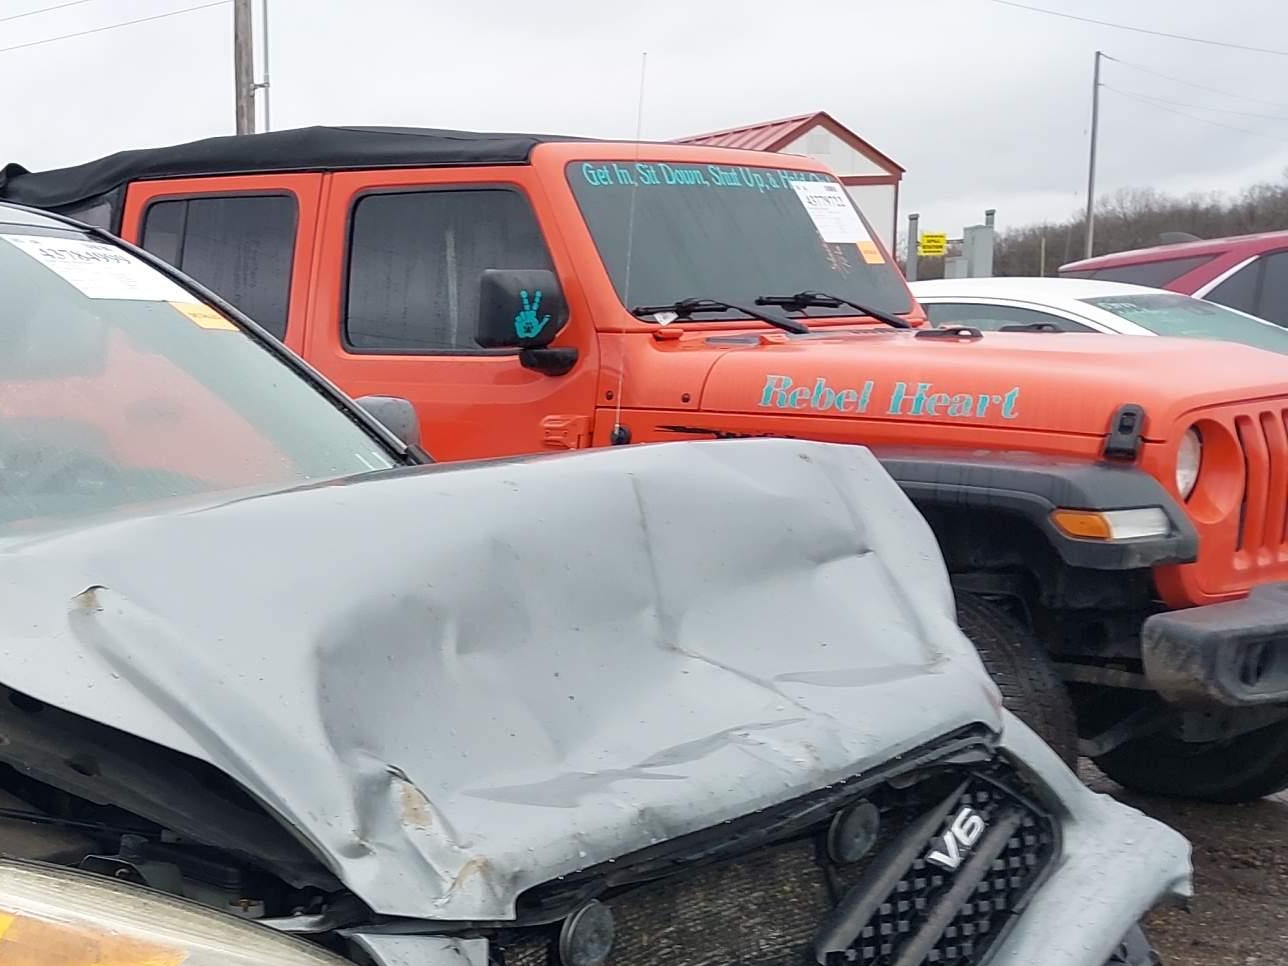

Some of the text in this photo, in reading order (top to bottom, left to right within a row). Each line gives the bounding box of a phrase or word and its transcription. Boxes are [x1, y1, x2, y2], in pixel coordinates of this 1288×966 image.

[582, 163, 609, 186] Get
[614, 163, 638, 187] In,
[636, 163, 657, 186] Sit
[659, 163, 710, 187] Down,
[708, 165, 742, 187] Shut
[758, 375, 1019, 419] Rebel Heart
[927, 807, 985, 869] V6
